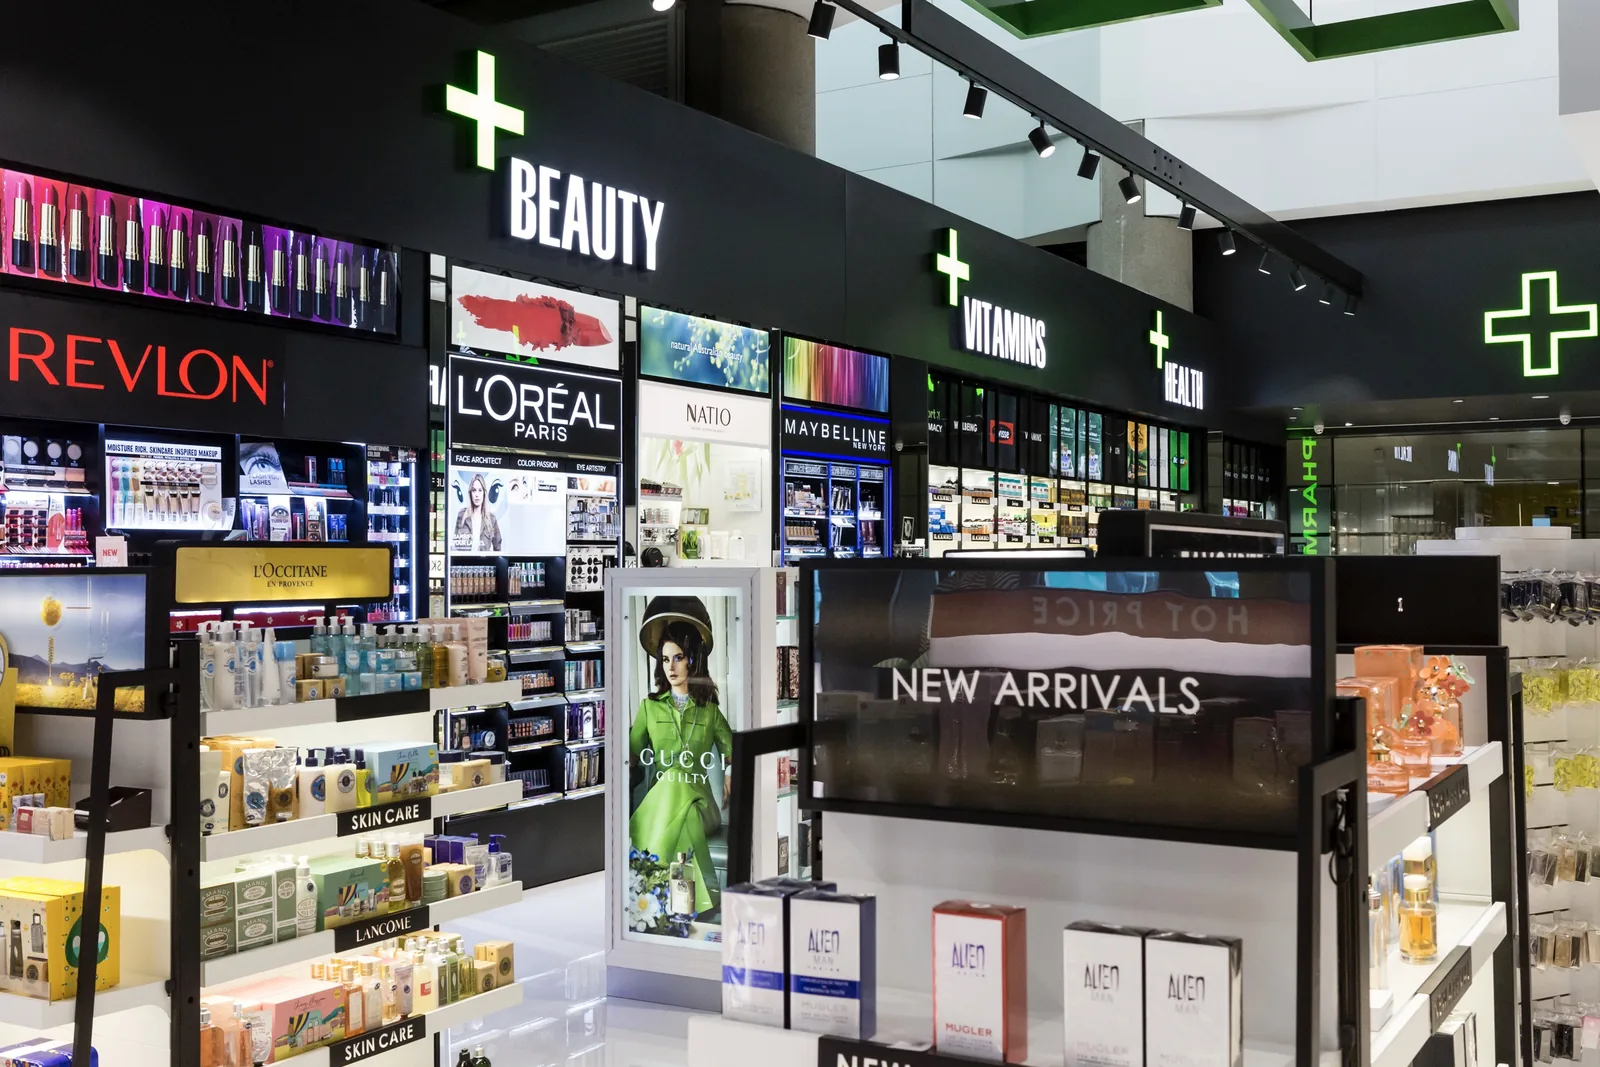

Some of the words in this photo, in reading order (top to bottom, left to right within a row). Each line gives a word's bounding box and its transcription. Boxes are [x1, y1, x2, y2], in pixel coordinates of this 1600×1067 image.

[511, 157, 664, 271] BEAUTY
[963, 296, 1047, 369] VITAMINS
[671, 341, 693, 352] natural
[693, 344, 722, 357] Australian
[724, 350, 743, 363] beauty
[9, 327, 267, 405] REVLON
[1164, 361, 1204, 410] HEALTH
[457, 374, 615, 430] L'ORÉAL
[686, 403, 731, 427] NATIO
[785, 418, 886, 445] MAYBELLINE
[107, 444, 133, 452] MOISTURE
[149, 447, 174, 455] SKINCARE
[853, 441, 867, 450] NEW
[869, 443, 886, 452] YORK
[455, 455, 470, 463] FACE
[471, 456, 502, 465] ARCHITECT
[517, 459, 536, 467] COLOR
[536, 461, 558, 469] PASSION
[103, 549, 118, 557] NEW
[254, 562, 327, 578] L'OCCITANE
[892, 668, 980, 704] NEW
[995, 671, 1200, 715] ARRIVALS
[640, 747, 726, 771] GUCCI
[656, 771, 709, 785] GUILTY
[351, 811, 381, 830] SKIN
[385, 804, 420, 824] CARE
[202, 889, 231, 900] AMANDE
[240, 881, 270, 894] AMANDE
[808, 928, 840, 955] ALIEN
[952, 941, 986, 971] ALIEN
[1084, 963, 1120, 992] ALIEN
[1168, 973, 1206, 1002] ALIEN
[345, 1038, 375, 1060] SKIN
[378, 1024, 414, 1048] CARE
[945, 1023, 993, 1036] MUGLER
